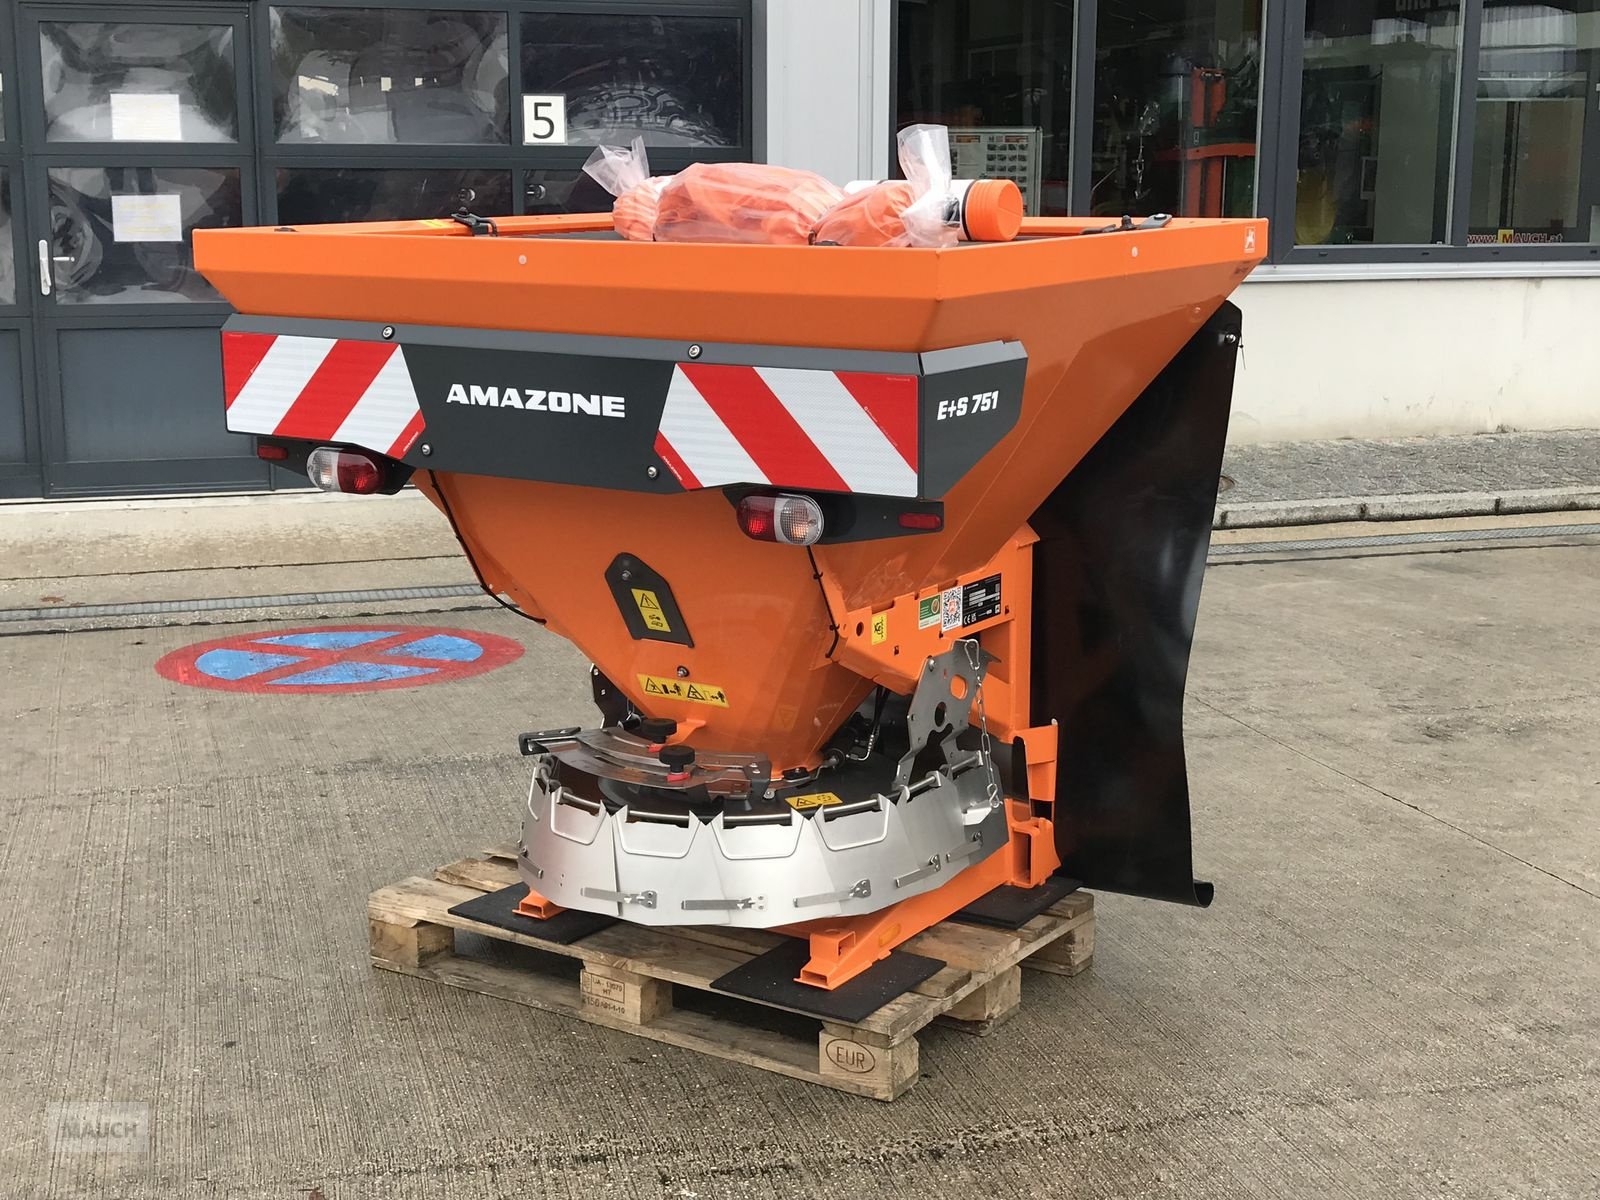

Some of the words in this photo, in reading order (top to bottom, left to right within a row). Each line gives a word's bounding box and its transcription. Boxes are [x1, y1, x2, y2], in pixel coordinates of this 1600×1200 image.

[532, 101, 555, 140] 5
[446, 383, 626, 418] AMAZONE
[937, 396, 969, 421] E+S
[971, 390, 999, 414] 751
[836, 1046, 865, 1070] EUR
